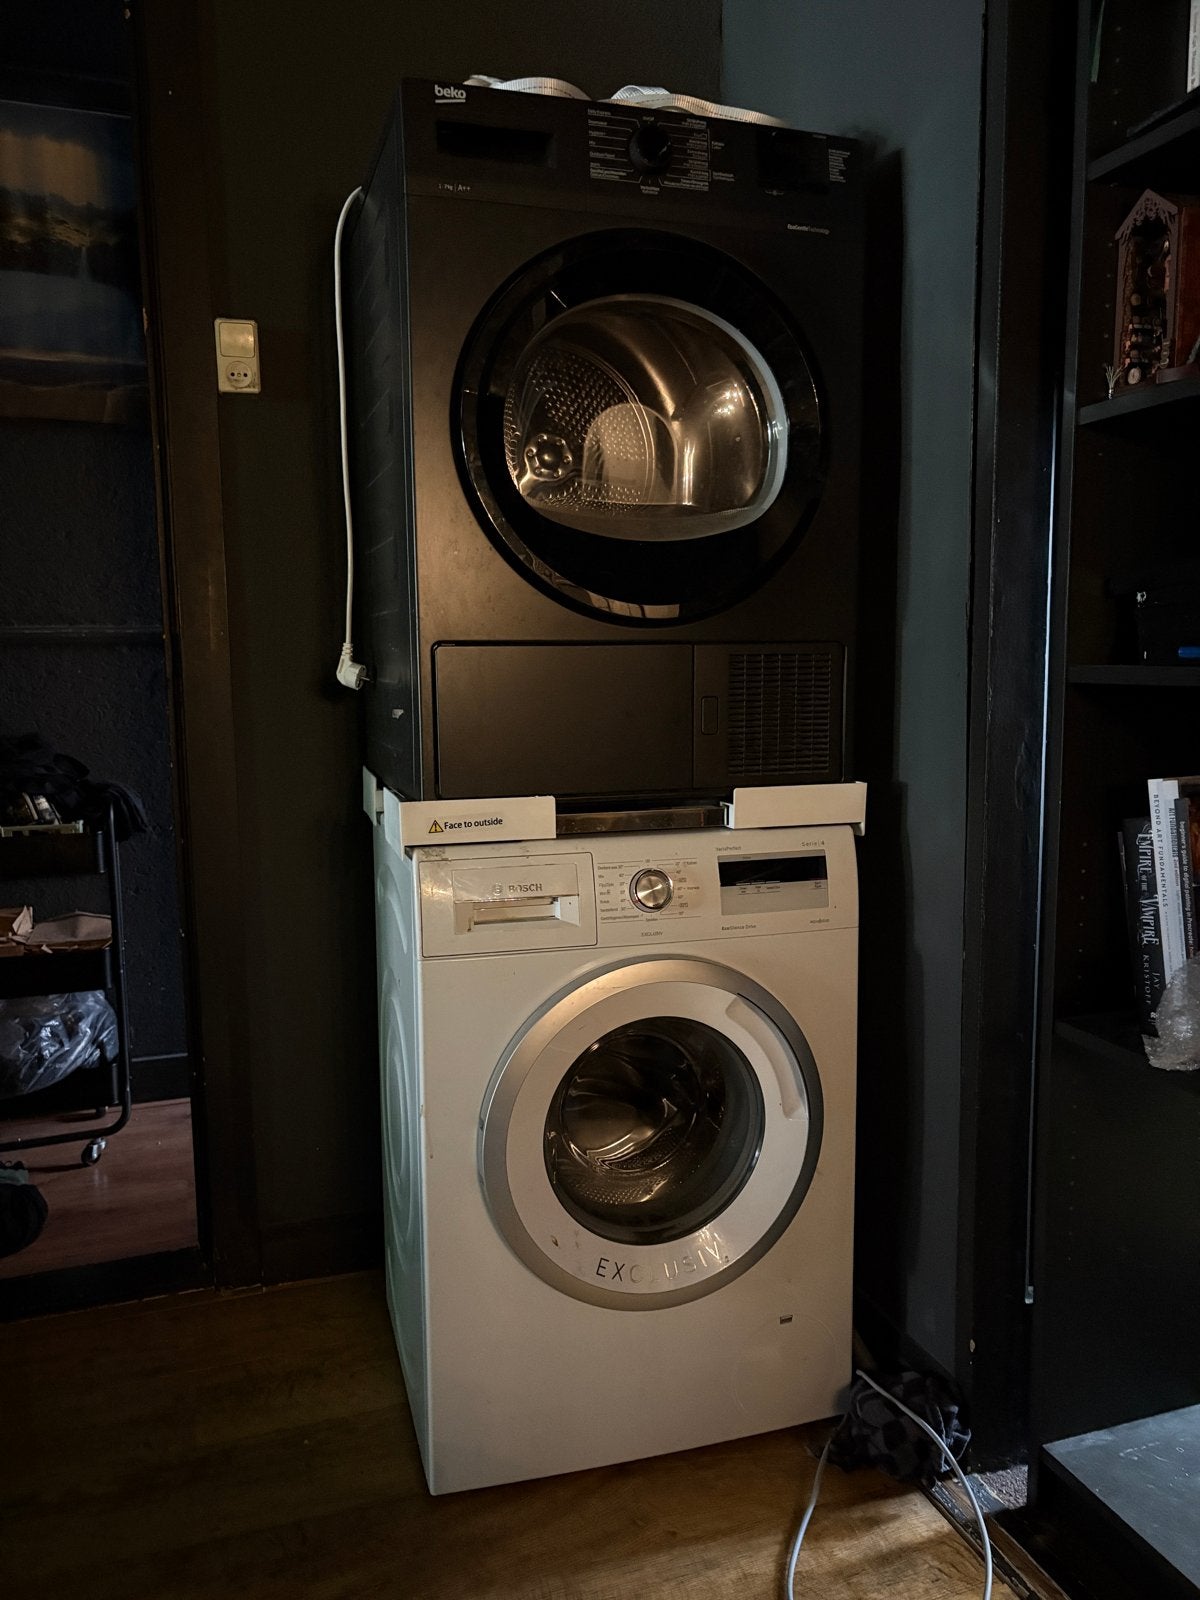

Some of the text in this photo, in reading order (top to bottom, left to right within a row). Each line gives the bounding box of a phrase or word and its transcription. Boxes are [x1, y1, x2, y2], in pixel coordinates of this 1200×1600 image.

[434, 84, 467, 99] beko
[1153, 794, 1162, 825] BEYOND
[444, 817, 503, 830] Face to outside
[1155, 828, 1163, 843] ART
[1136, 831, 1154, 874] EMPIRE
[1157, 846, 1169, 907] FUNDAMENTALS
[1183, 872, 1191, 888] digital
[508, 883, 543, 893] BOSCH
[1139, 894, 1160, 946] VAMPIRE
[1151, 972, 1161, 990] JAY
